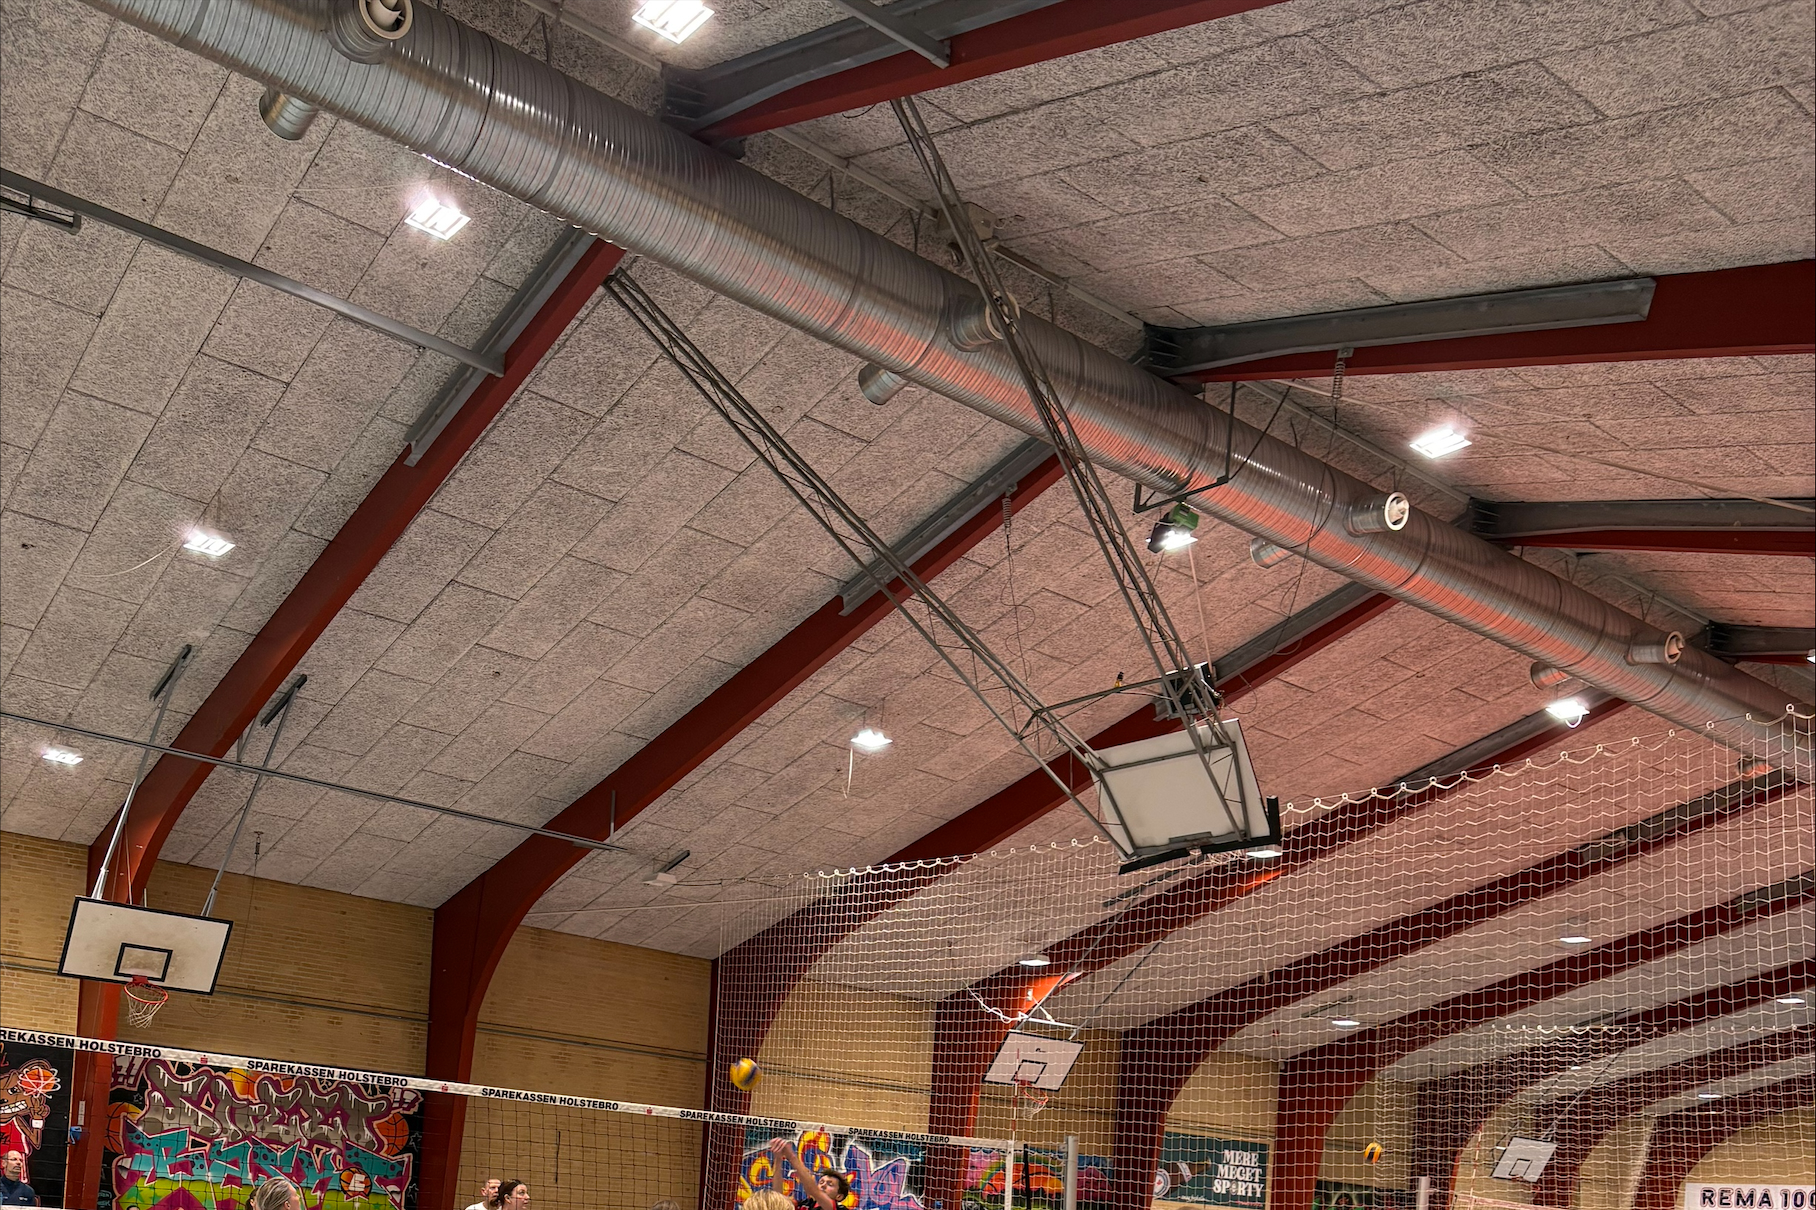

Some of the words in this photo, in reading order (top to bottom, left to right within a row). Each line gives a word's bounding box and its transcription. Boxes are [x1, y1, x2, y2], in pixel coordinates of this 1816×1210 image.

[79, 1040, 161, 1058] HOLSTEBRO
[247, 1060, 335, 1079] SPAREKASSEN
[338, 1070, 408, 1087] HOLSTEBRO
[481, 1087, 557, 1104] SPAREKASSEN
[559, 1096, 619, 1111] HOLSTEBRO
[679, 1110, 744, 1125] SPAREKASSEN
[746, 1117, 797, 1129] HOLSTEBRO
[849, 1127, 904, 1139] SPAREKASSEN
[905, 1132, 950, 1144] HOLSTEBRO
[1222, 1149, 1259, 1167] MERE
[1216, 1164, 1263, 1182] MEGET
[1700, 1187, 1774, 1209] REMA
